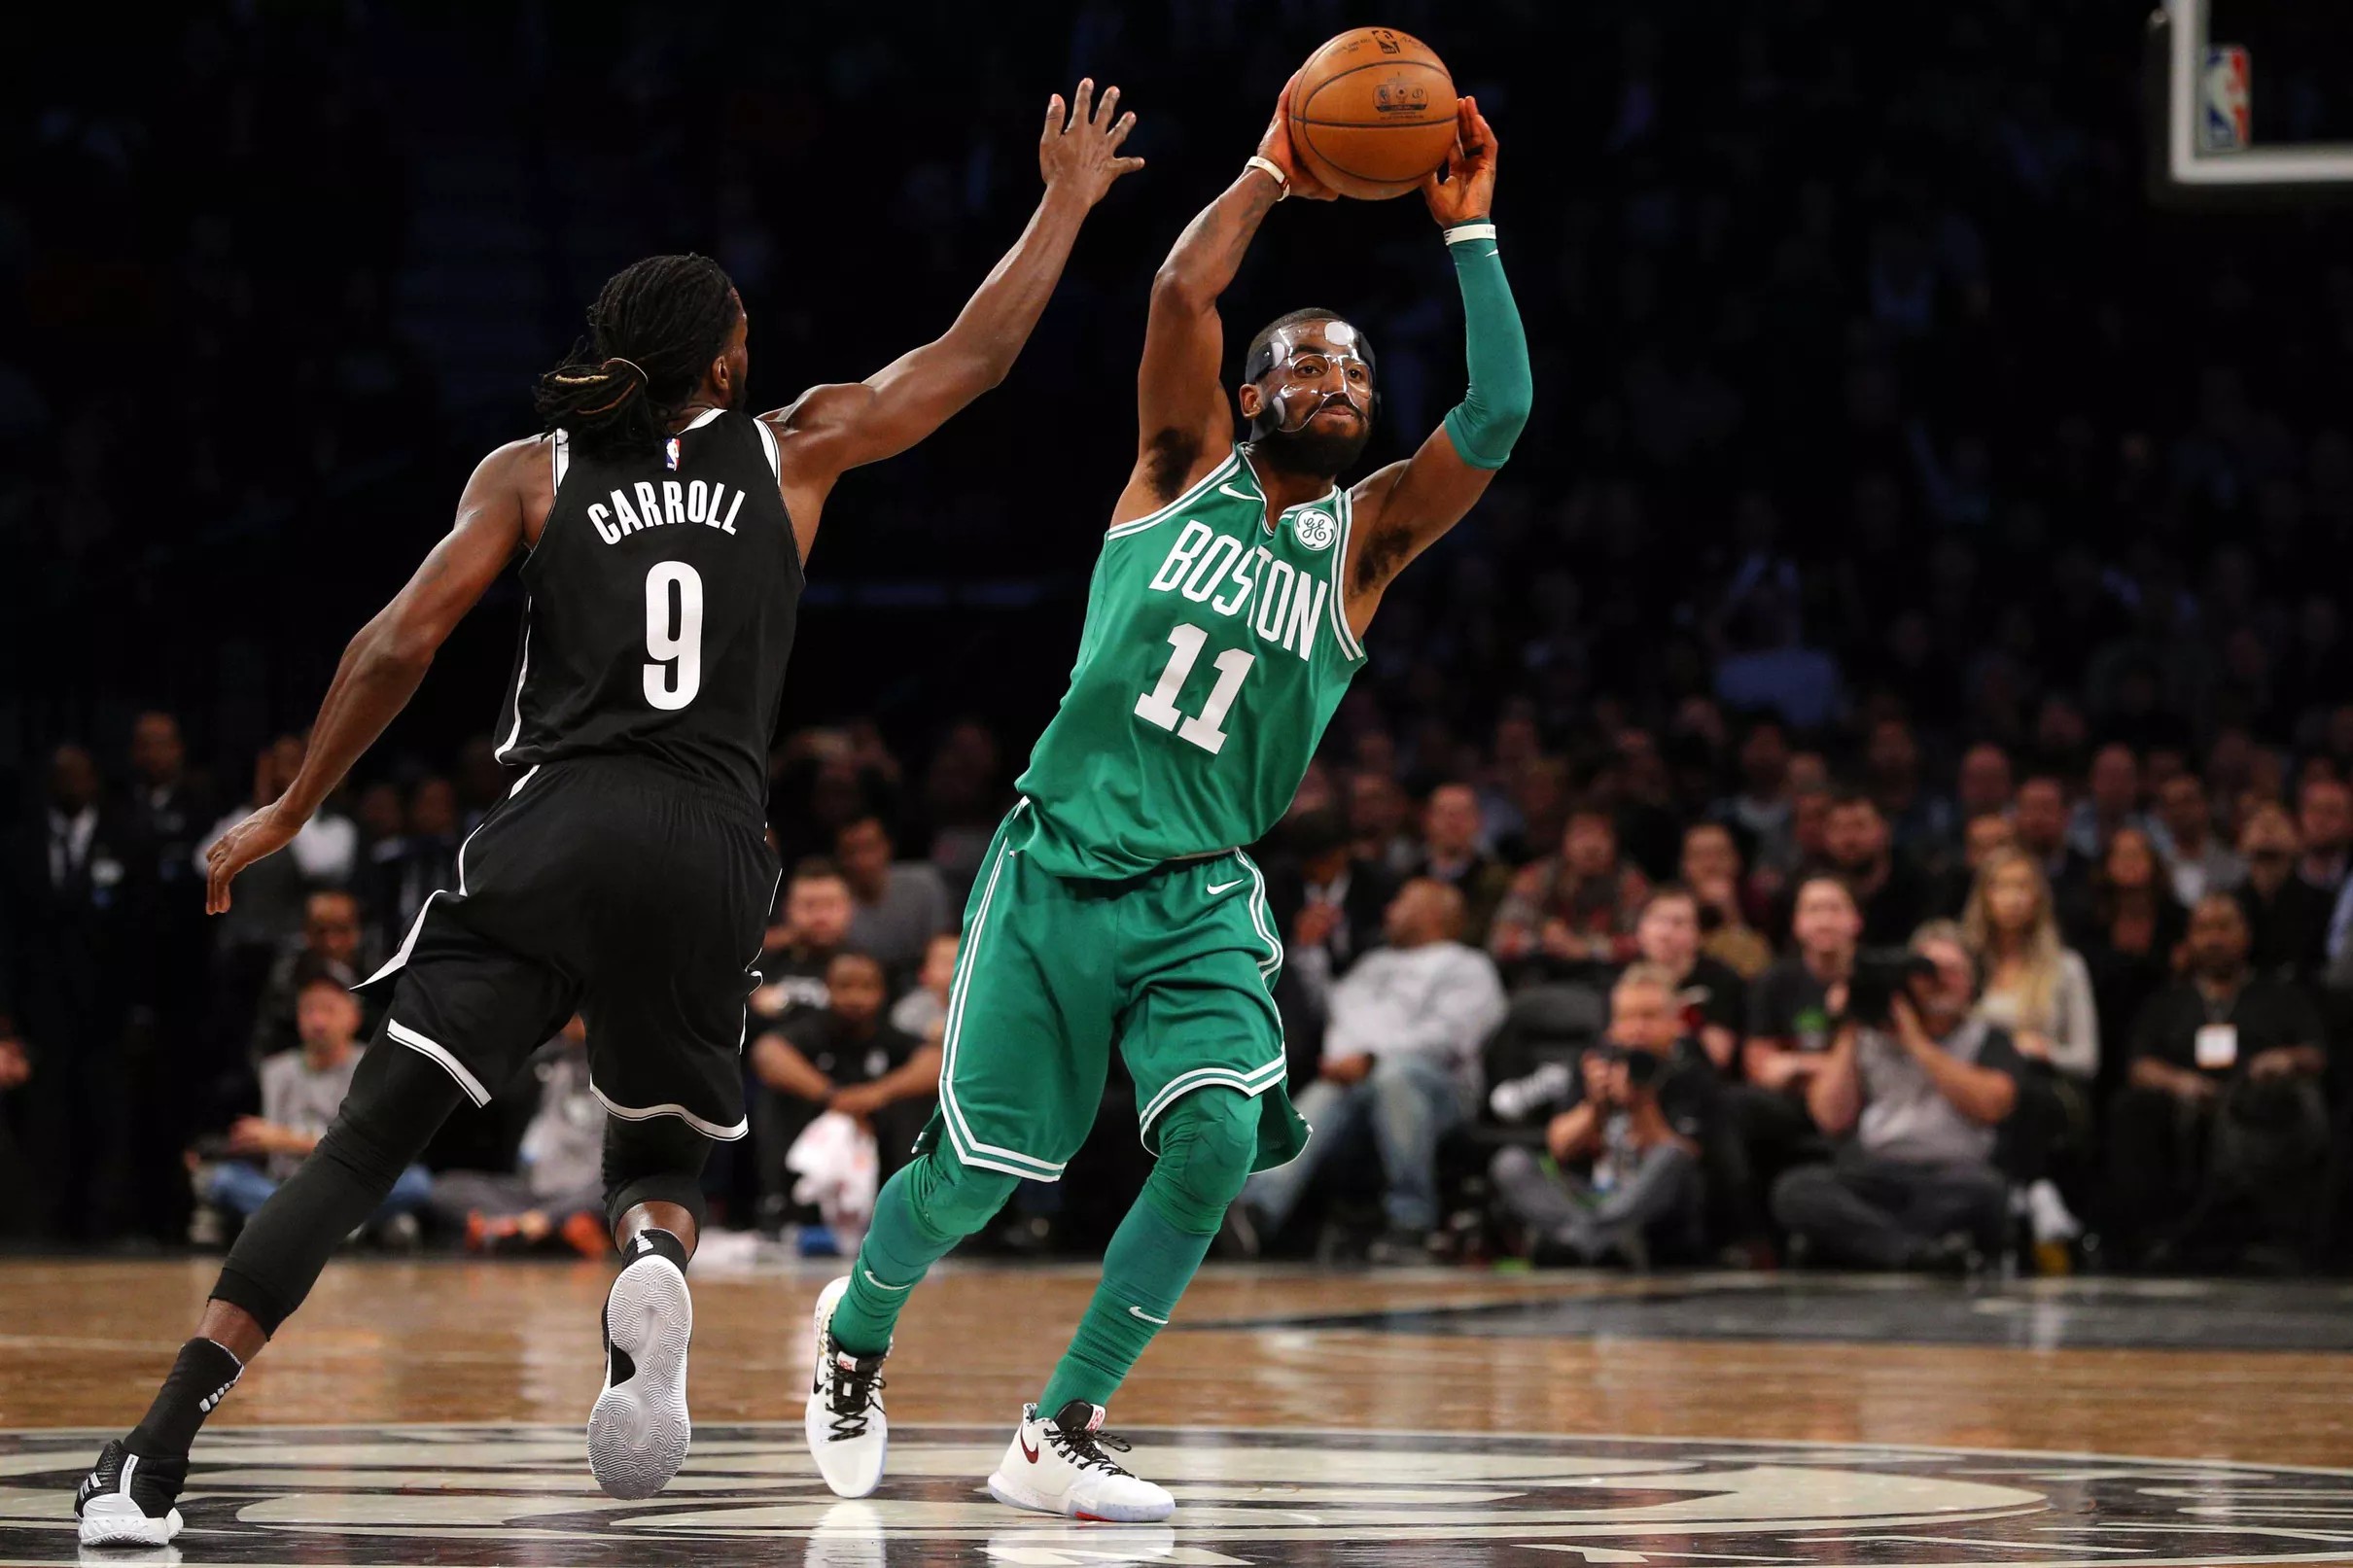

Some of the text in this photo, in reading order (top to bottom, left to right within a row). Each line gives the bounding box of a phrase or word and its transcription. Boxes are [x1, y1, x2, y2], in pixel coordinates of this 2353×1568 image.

[587, 480, 746, 545] CARROLL
[643, 560, 703, 711] 9
[1148, 519, 1328, 662] BOSTON
[1134, 623, 1255, 754] 11
